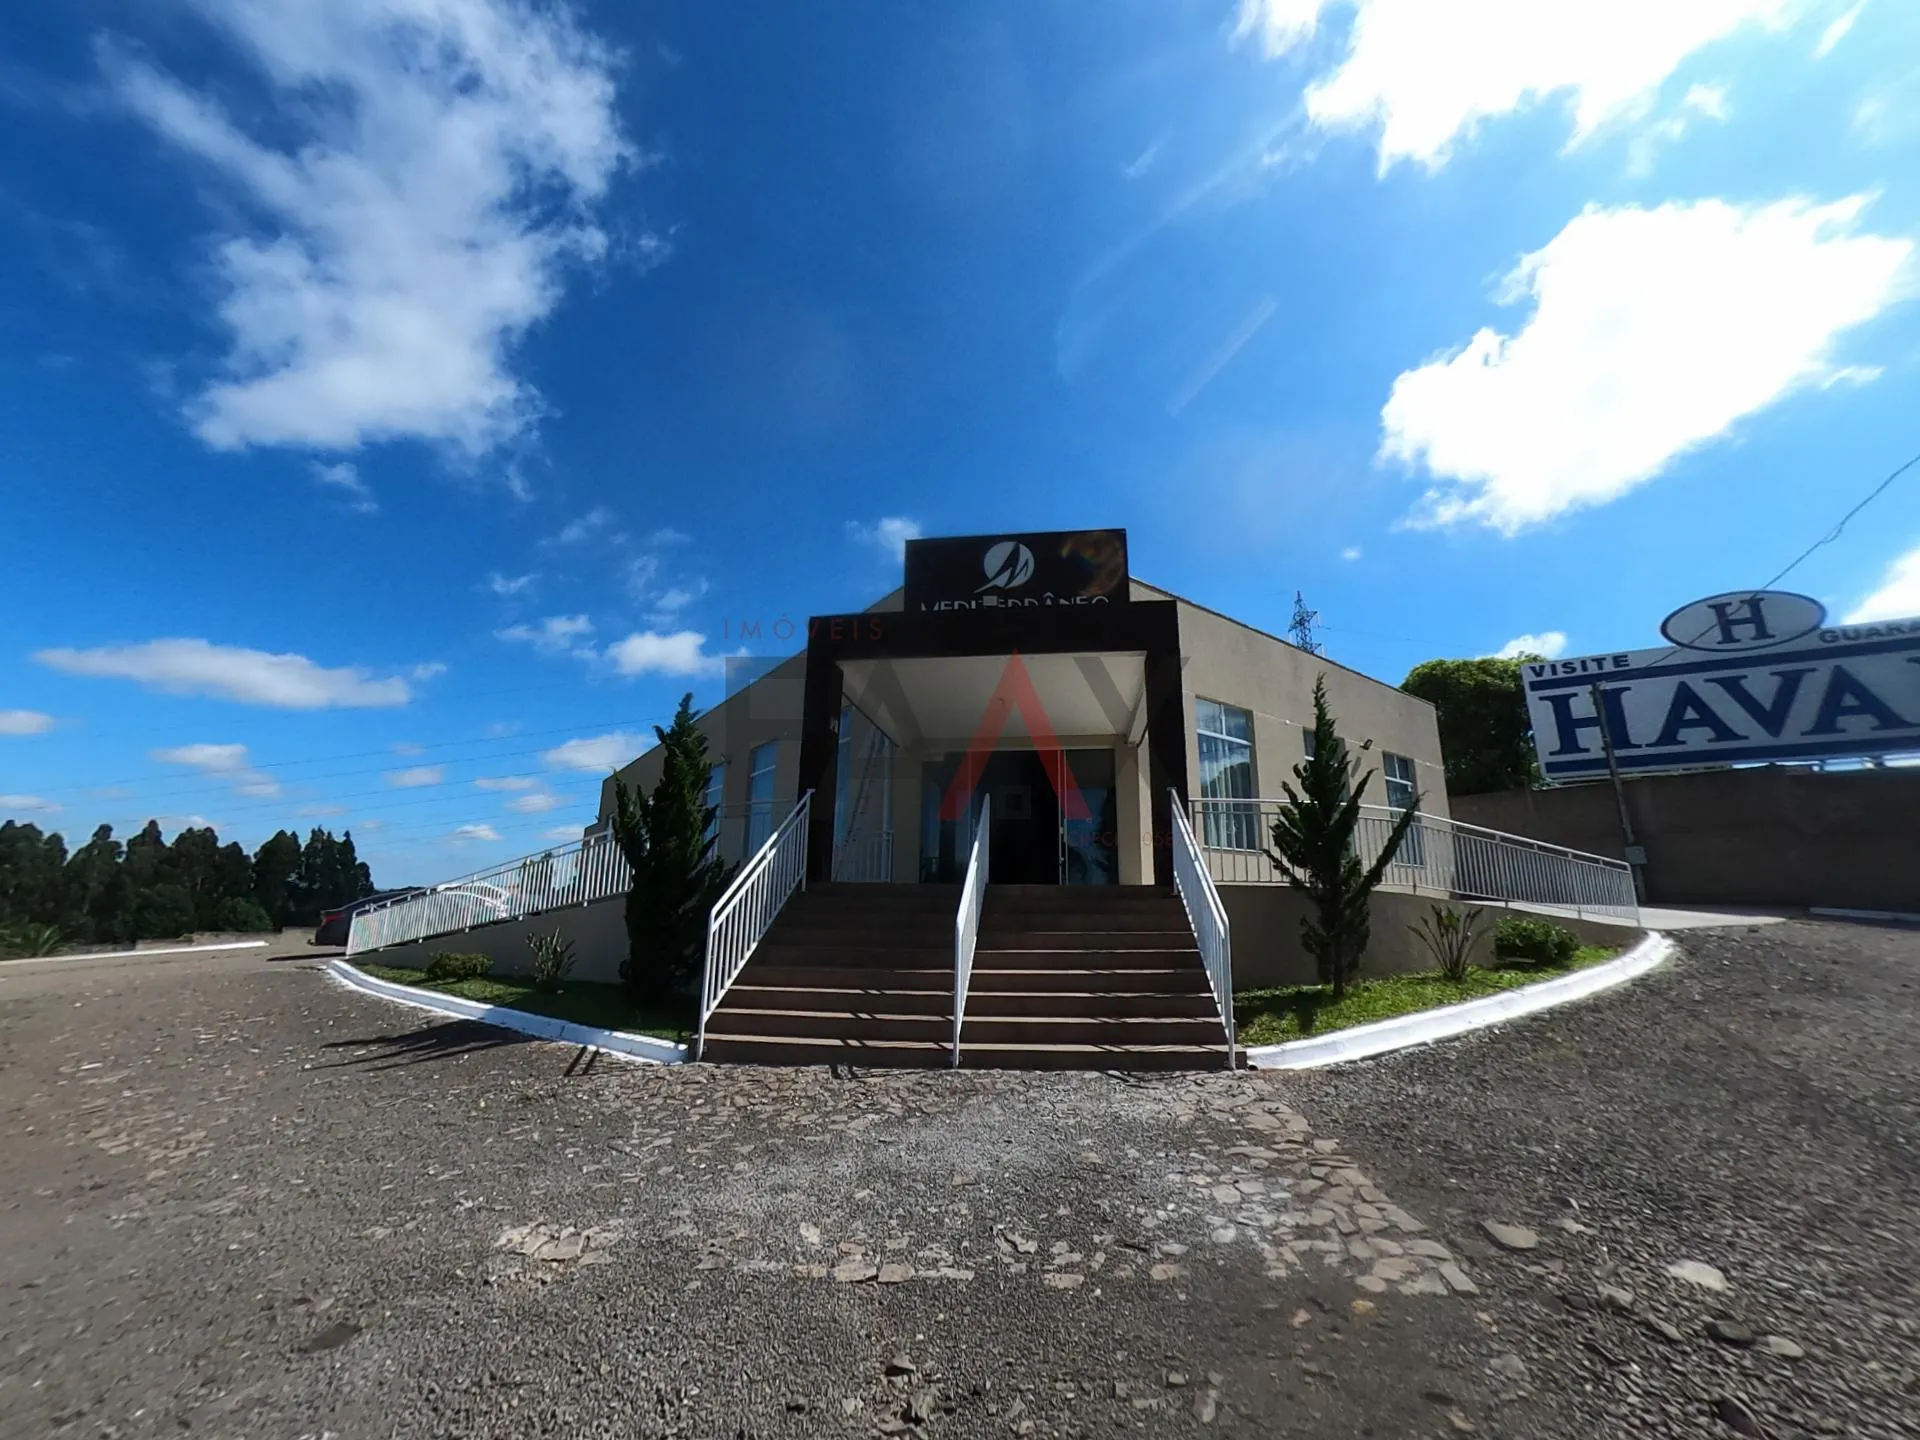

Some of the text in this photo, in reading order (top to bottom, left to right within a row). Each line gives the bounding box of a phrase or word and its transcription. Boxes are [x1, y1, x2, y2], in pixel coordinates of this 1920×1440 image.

[1708, 597, 1775, 645] H
[1529, 654, 1631, 678] VISITE
[1539, 655, 1920, 756] HAVA
